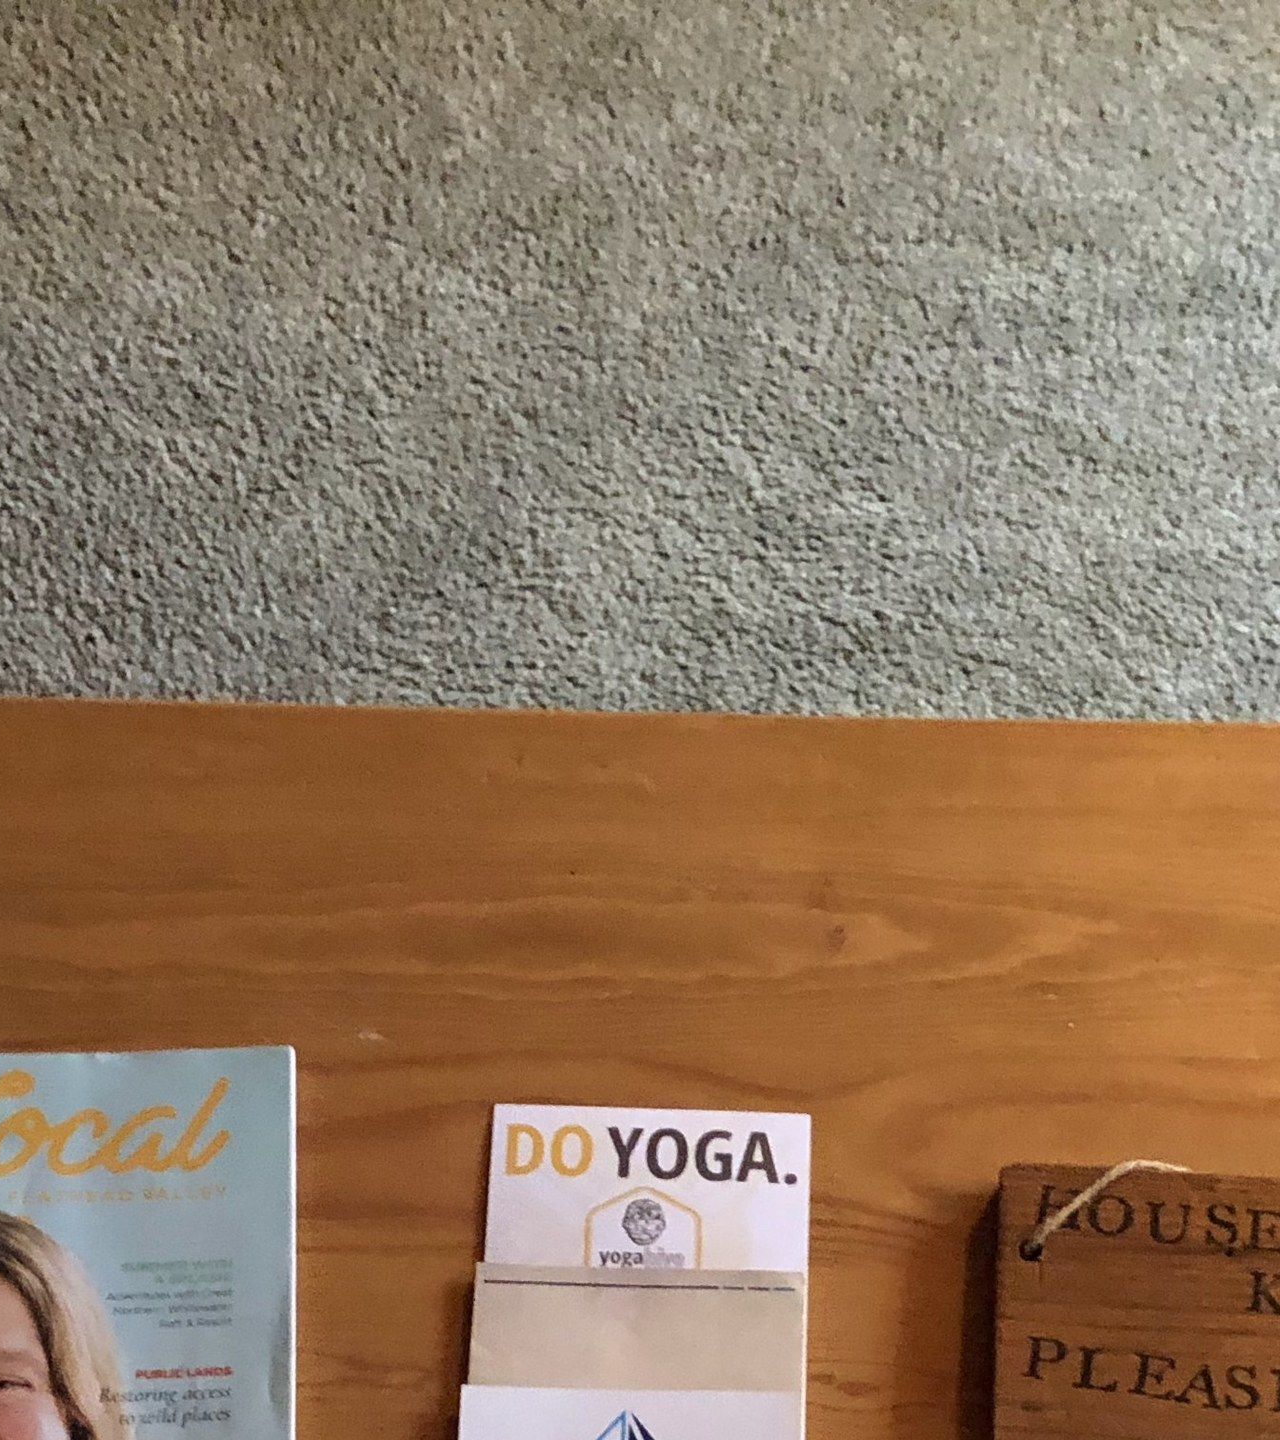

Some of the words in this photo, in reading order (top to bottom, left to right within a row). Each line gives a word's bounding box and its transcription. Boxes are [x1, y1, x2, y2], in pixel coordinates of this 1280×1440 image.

[504, 1123, 593, 1177] DO
[607, 1125, 798, 1186] YOGA.
[135, 1368, 182, 1380] PUBLIC
[186, 1366, 234, 1378] LANDS
[99, 1387, 178, 1405] Restoring
[182, 1387, 232, 1401] access
[138, 1407, 177, 1424] wild
[180, 1406, 232, 1428] places
